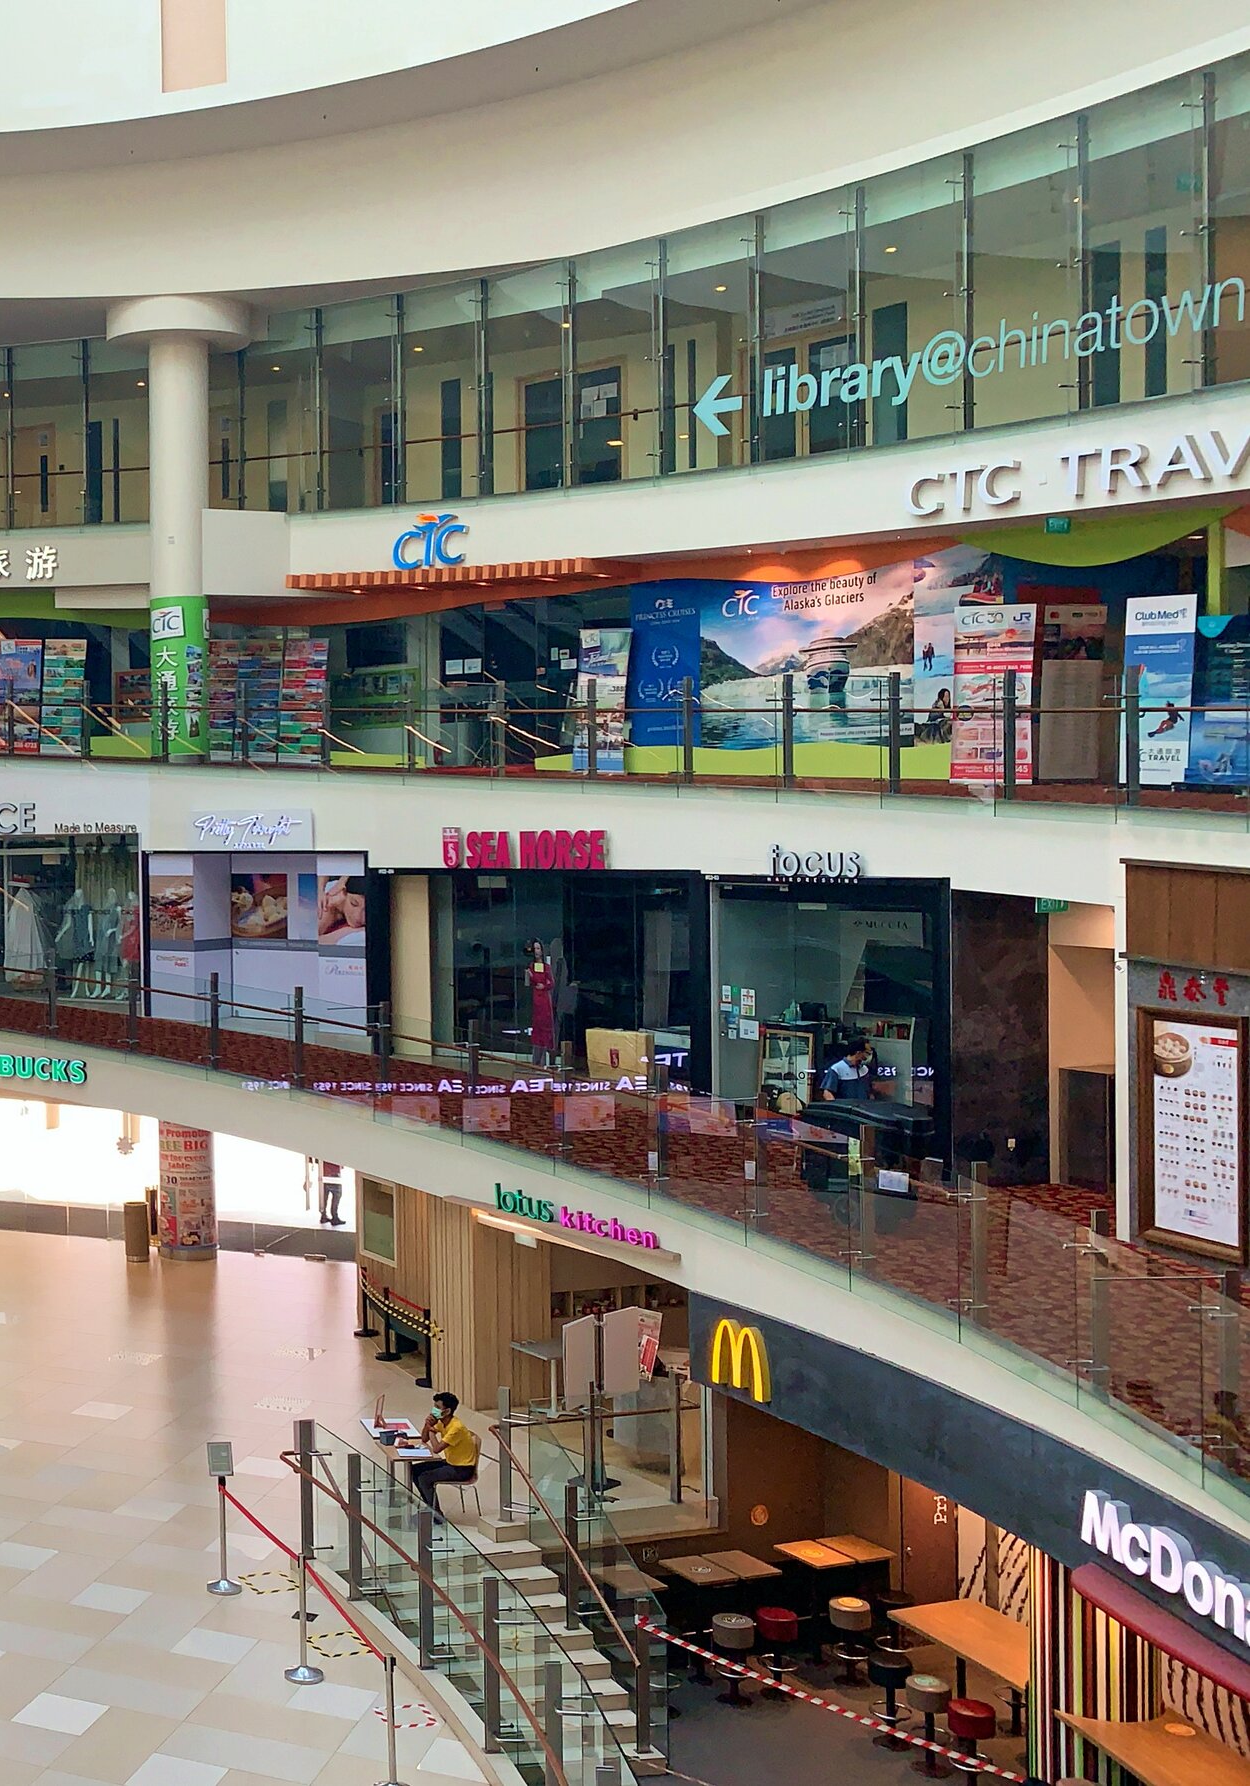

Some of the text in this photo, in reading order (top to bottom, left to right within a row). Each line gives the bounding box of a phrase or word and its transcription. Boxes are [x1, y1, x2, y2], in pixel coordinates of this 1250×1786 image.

[763, 276, 1246, 417] library@chinatown
[908, 459, 1021, 516] CTC
[392, 514, 469, 570] CTC
[772, 572, 878, 598] Explore the beauty of
[668, 607, 696, 617] CRUISES
[722, 589, 760, 617] CTC
[783, 592, 865, 612] Alaska's Glaciers
[152, 611, 180, 634] CTC
[961, 612, 1003, 625] CTC 30
[1013, 612, 1031, 622] JR
[1135, 610, 1179, 621] Club Med
[54, 822, 81, 833] Made
[83, 822, 93, 833] to
[96, 821, 138, 833] Measure
[466, 830, 606, 870] SEA HORSE
[1041, 898, 1059, 910] EXIT
[183, 1140, 209, 1152] BIG
[494, 1182, 660, 1250] lotus kitchen
[1080, 1489, 1250, 1646] McDon
